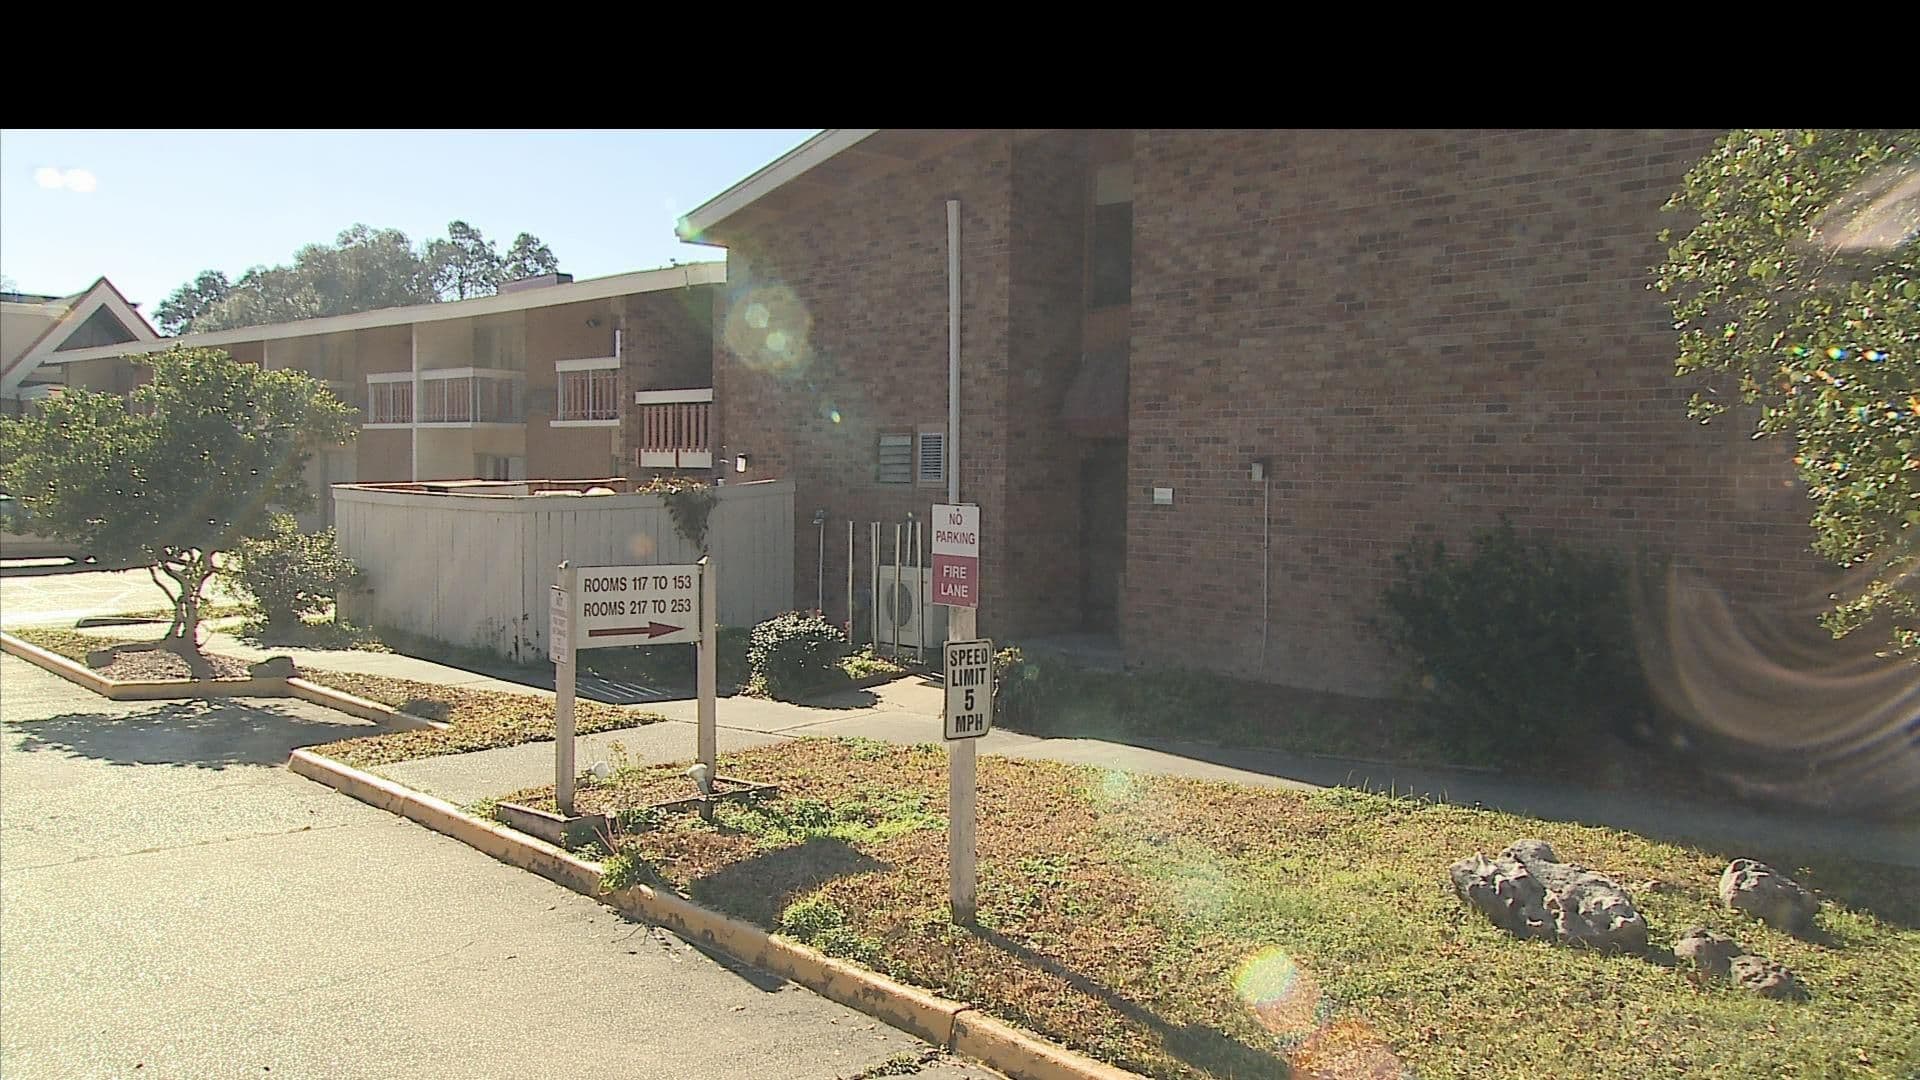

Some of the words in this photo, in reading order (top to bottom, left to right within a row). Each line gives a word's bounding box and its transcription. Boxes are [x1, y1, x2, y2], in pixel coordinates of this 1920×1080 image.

[949, 513, 963, 526] NO
[936, 530, 976, 545] PARKING
[943, 565, 967, 579] FIRE
[584, 577, 627, 593] ROOMS
[632, 576, 649, 591] 117
[652, 575, 668, 590] TO
[673, 575, 692, 590] 153
[940, 583, 969, 598] LANE
[583, 600, 625, 617] ROOMS
[630, 600, 648, 615] 217
[651, 599, 666, 614] TO
[671, 598, 691, 613] 253
[950, 647, 988, 667] SPEED
[952, 667, 987, 687] LIMIT
[964, 688, 975, 711] 5
[955, 713, 983, 733] MPH
